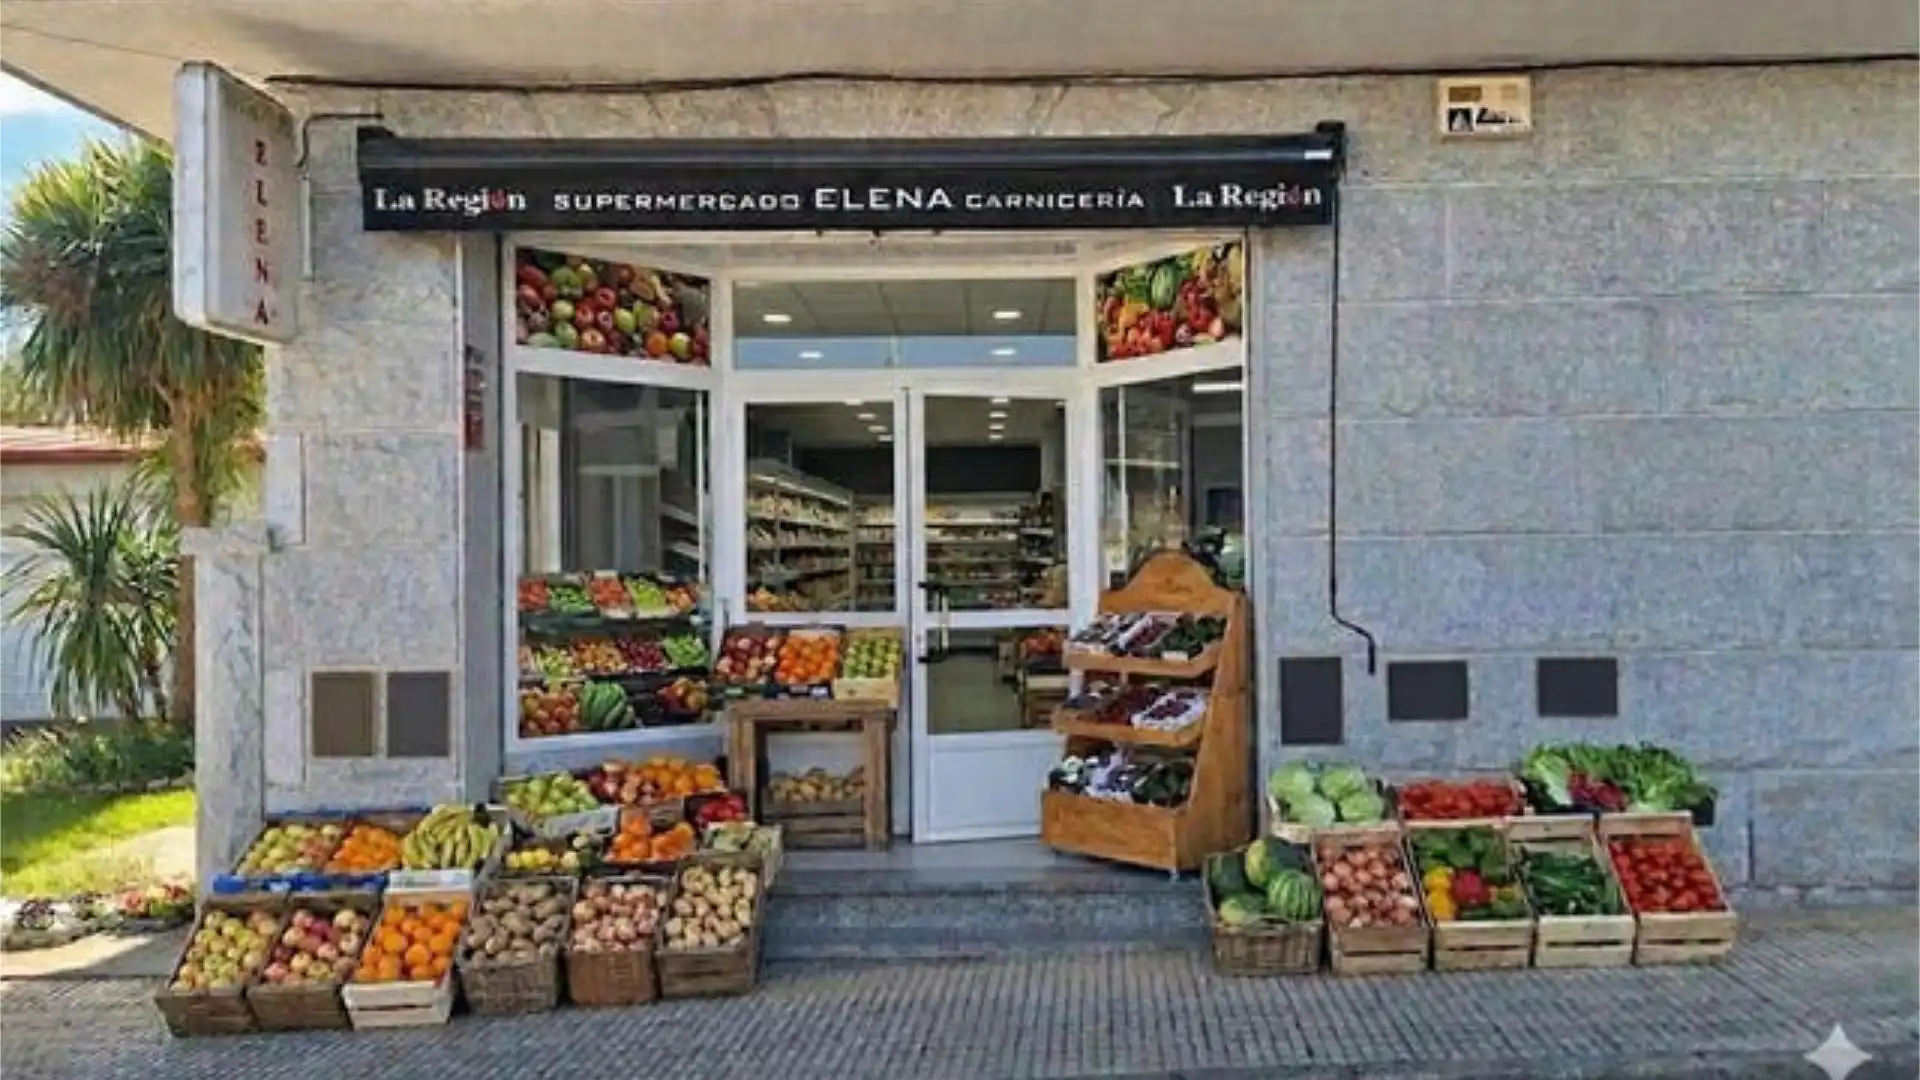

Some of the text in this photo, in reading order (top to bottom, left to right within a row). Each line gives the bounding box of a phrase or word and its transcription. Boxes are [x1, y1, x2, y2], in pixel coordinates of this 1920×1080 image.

[254, 139, 269, 325] ELENA
[373, 188, 416, 211] La
[553, 193, 800, 211] SUPERMERCADO
[814, 187, 952, 211] ELENA
[965, 187, 1145, 209] CARNICERÍA
[1173, 184, 1213, 208] La
